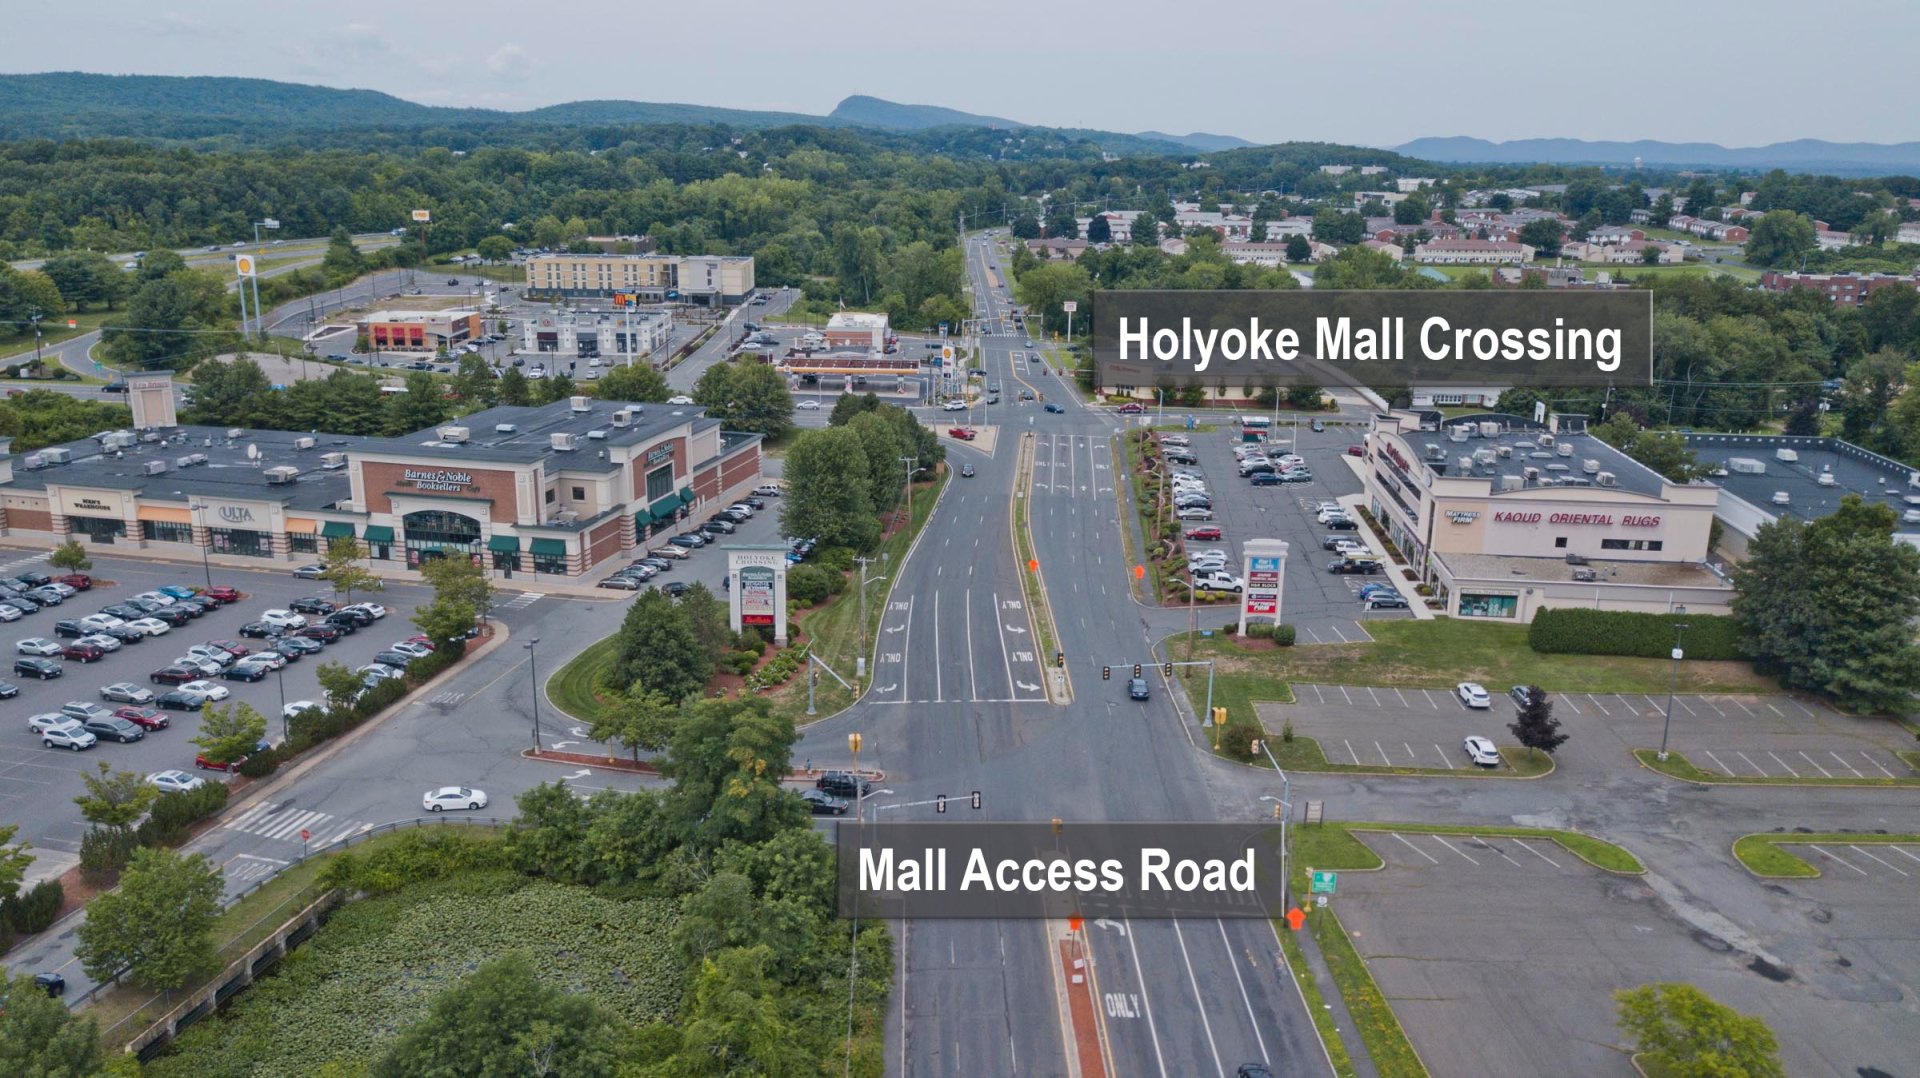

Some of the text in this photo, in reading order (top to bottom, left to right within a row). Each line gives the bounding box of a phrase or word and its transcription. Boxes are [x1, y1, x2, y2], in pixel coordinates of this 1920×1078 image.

[405, 469, 436, 480] Barnes
[446, 472, 472, 483] Noble
[416, 481, 462, 492] Booksellers
[218, 506, 255, 523] ULTA
[1494, 511, 1661, 528] KAOUD ORIENTAL RUGS
[1452, 517, 1473, 525] FIRM
[888, 602, 909, 611] ONLY
[1002, 600, 1022, 610] ONLY
[879, 652, 901, 664] ONLY
[1012, 651, 1033, 662] ONLY
[1104, 993, 1141, 1019] ONLY
